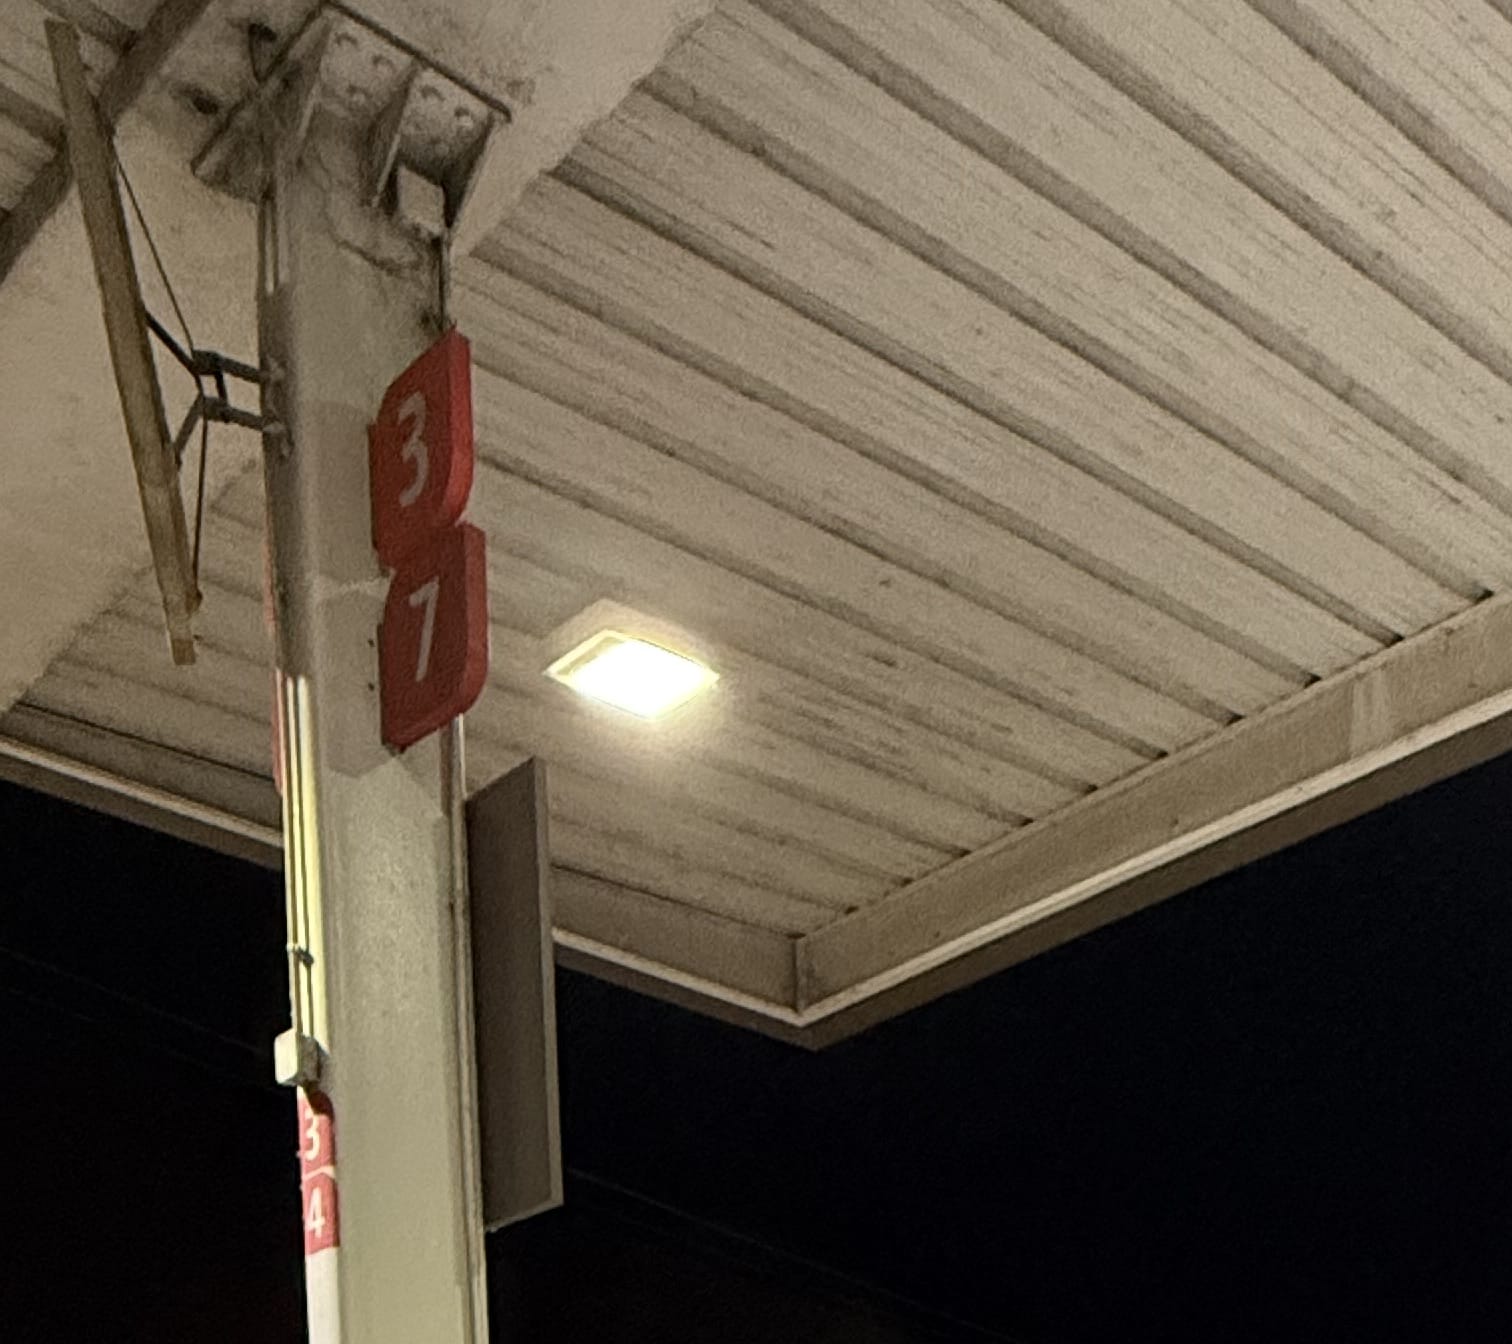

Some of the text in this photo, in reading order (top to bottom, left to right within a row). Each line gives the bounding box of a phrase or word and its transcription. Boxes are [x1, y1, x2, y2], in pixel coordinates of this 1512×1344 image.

[398, 391, 430, 508] 3
[304, 1107, 321, 1161] 3
[306, 1186, 326, 1238] 4
